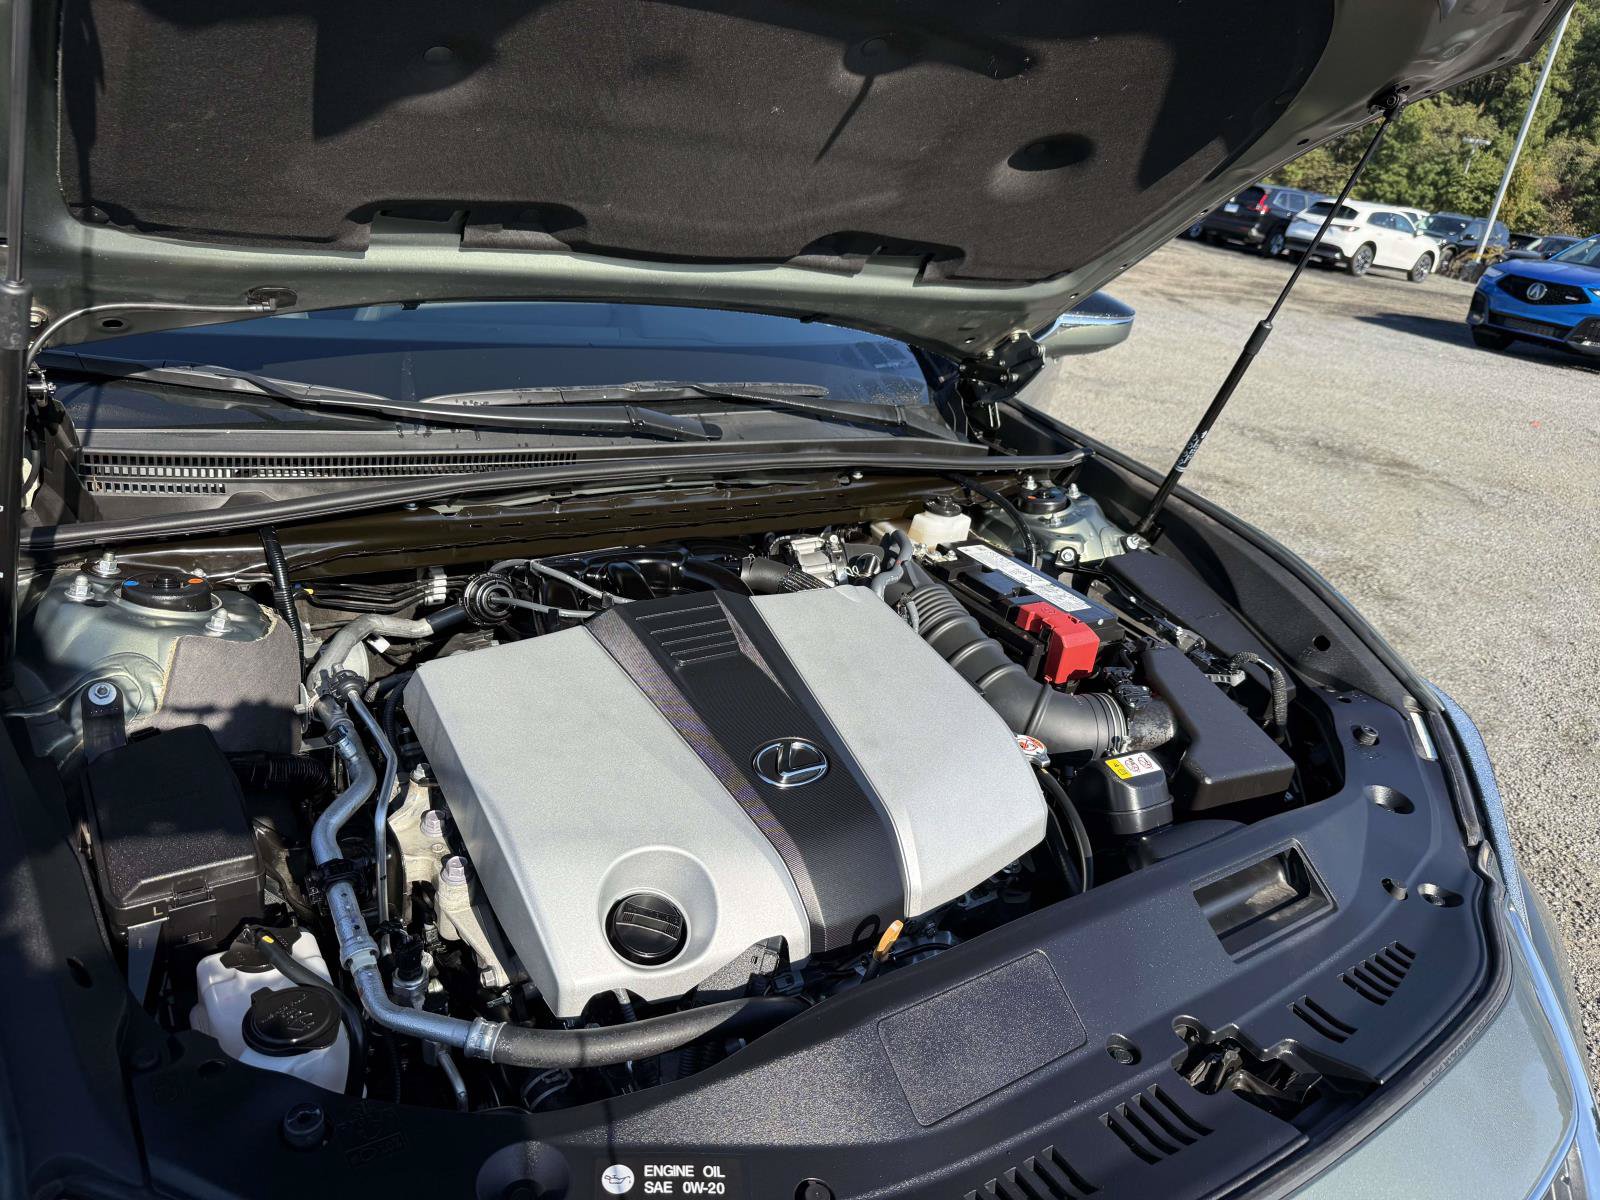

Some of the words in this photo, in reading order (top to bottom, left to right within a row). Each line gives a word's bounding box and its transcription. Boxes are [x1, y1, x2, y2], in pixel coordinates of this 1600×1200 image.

[152, 906, 164, 917] L
[643, 1164, 695, 1178] ENGINE
[702, 1165, 726, 1178] OIL
[643, 1180, 673, 1194] SAE
[682, 1181, 725, 1195] 0W-20
